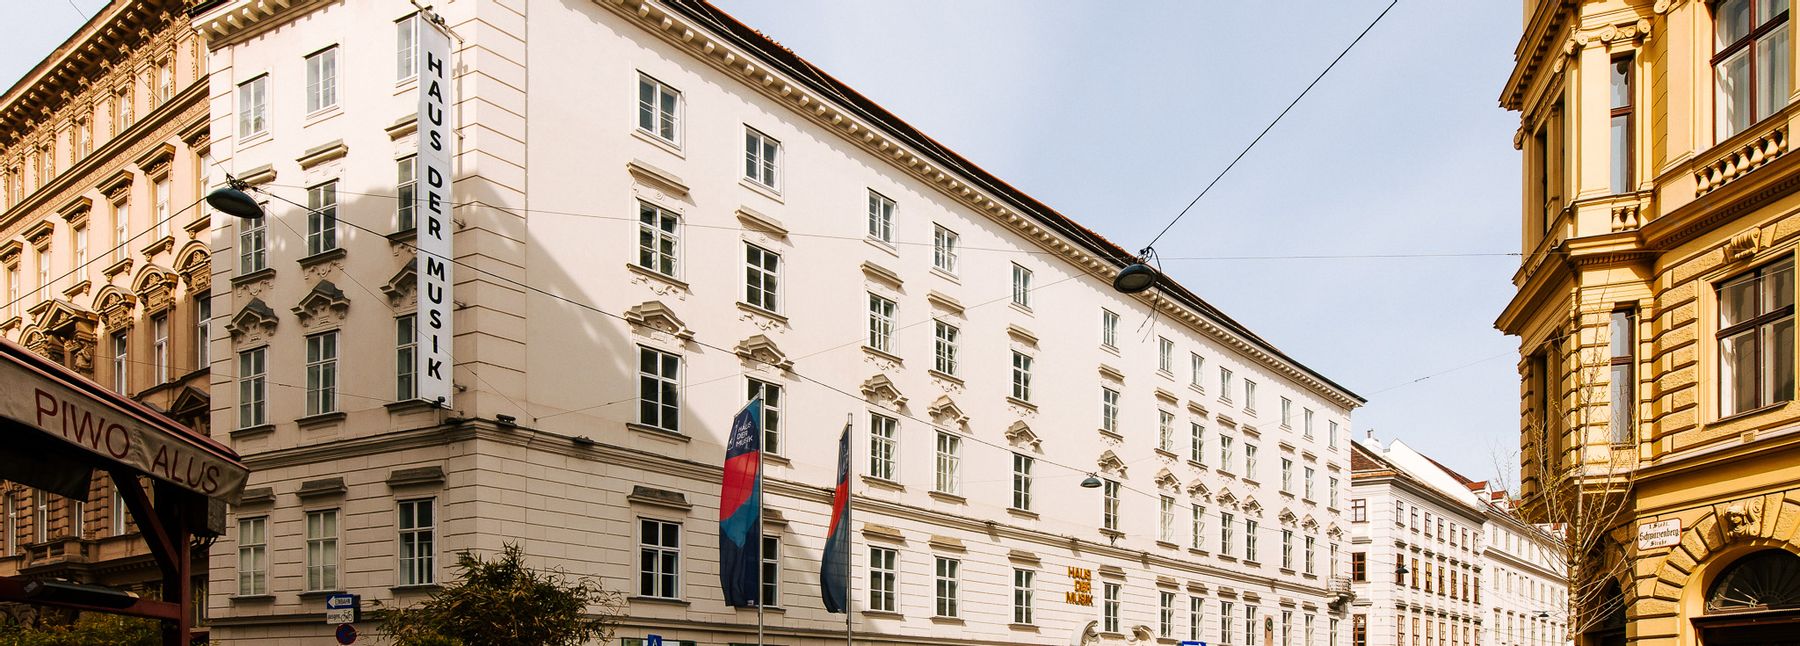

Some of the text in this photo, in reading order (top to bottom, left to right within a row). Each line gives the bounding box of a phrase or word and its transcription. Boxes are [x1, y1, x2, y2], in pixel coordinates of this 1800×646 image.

[427, 51, 445, 381] HAUS DER MUSIK
[738, 421, 752, 432] HAUS
[35, 387, 220, 494] PIWO ALUS
[735, 435, 753, 447] MUSIK
[736, 430, 748, 440] DER
[1067, 565, 1092, 580] HAUS
[1074, 580, 1092, 594] DER
[1065, 591, 1093, 607] MUSIK
